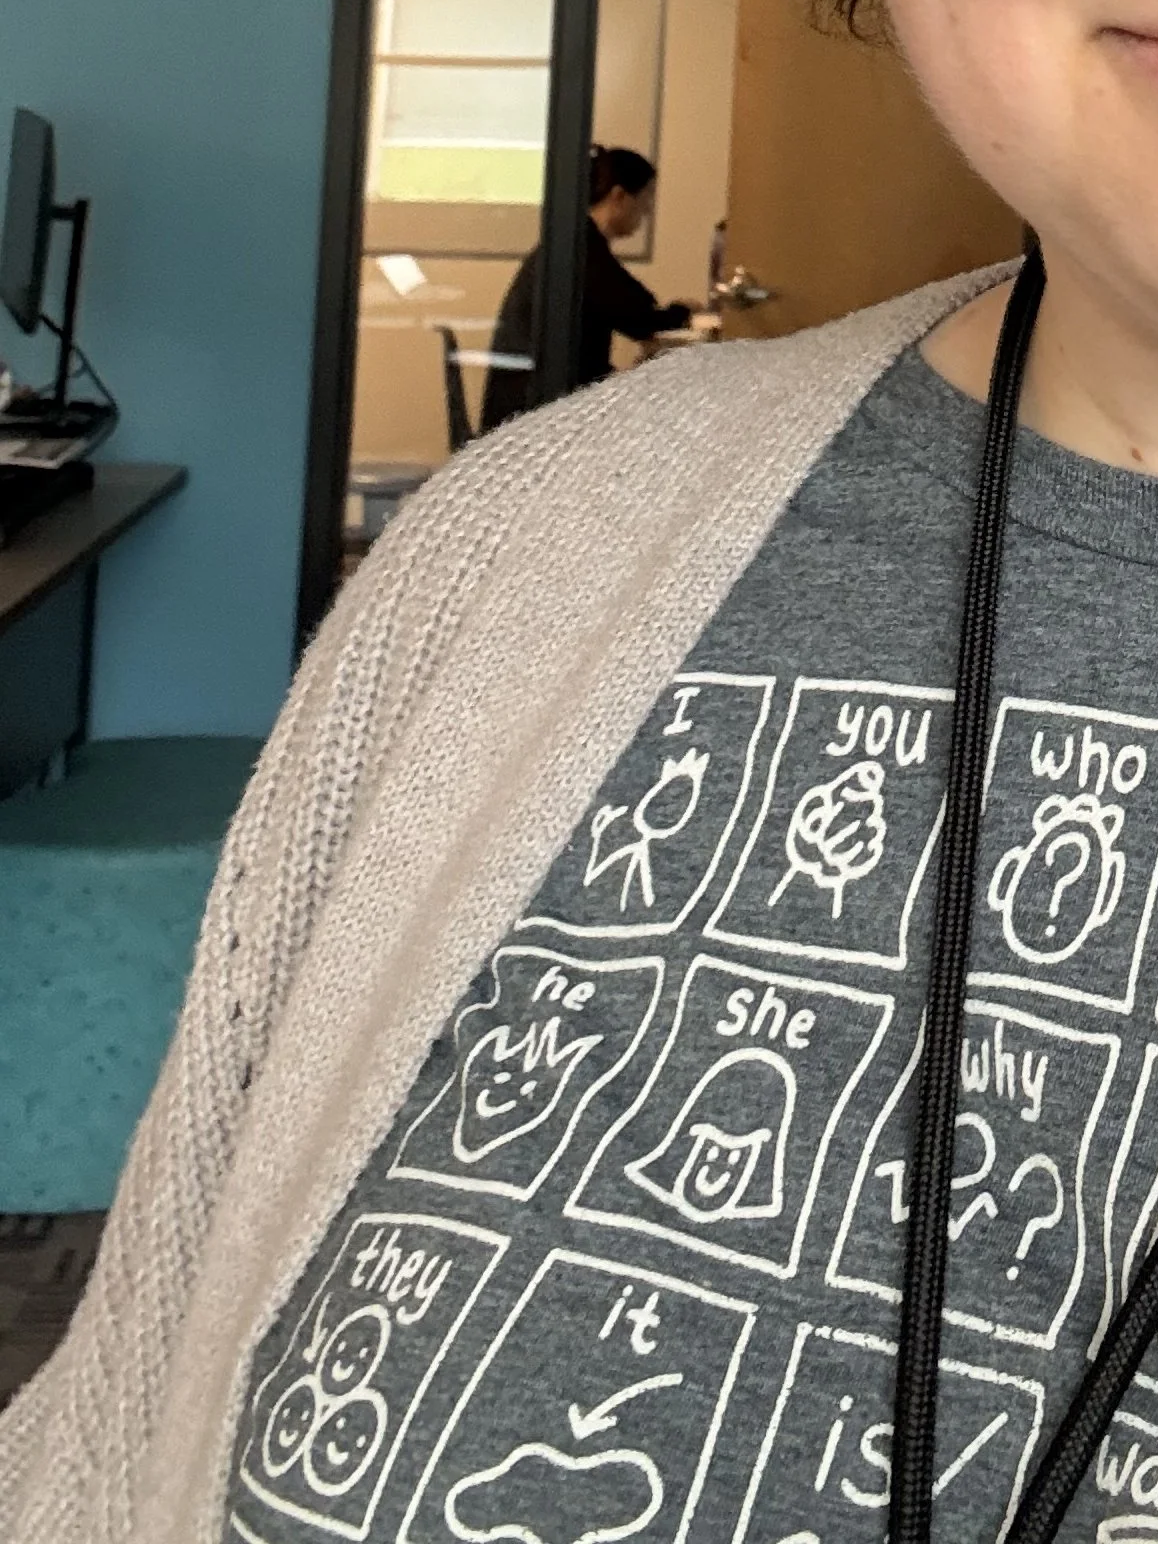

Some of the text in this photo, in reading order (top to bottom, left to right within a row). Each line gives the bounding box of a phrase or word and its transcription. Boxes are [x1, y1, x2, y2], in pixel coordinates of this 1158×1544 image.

[662, 686, 701, 736] I
[825, 701, 932, 766] you
[1030, 725, 1147, 794] who
[531, 965, 596, 1012] he
[715, 986, 817, 1049] she
[960, 1018, 1049, 1123] why
[348, 1228, 454, 1327] they
[597, 1284, 663, 1355] it
[814, 1394, 894, 1509] is
